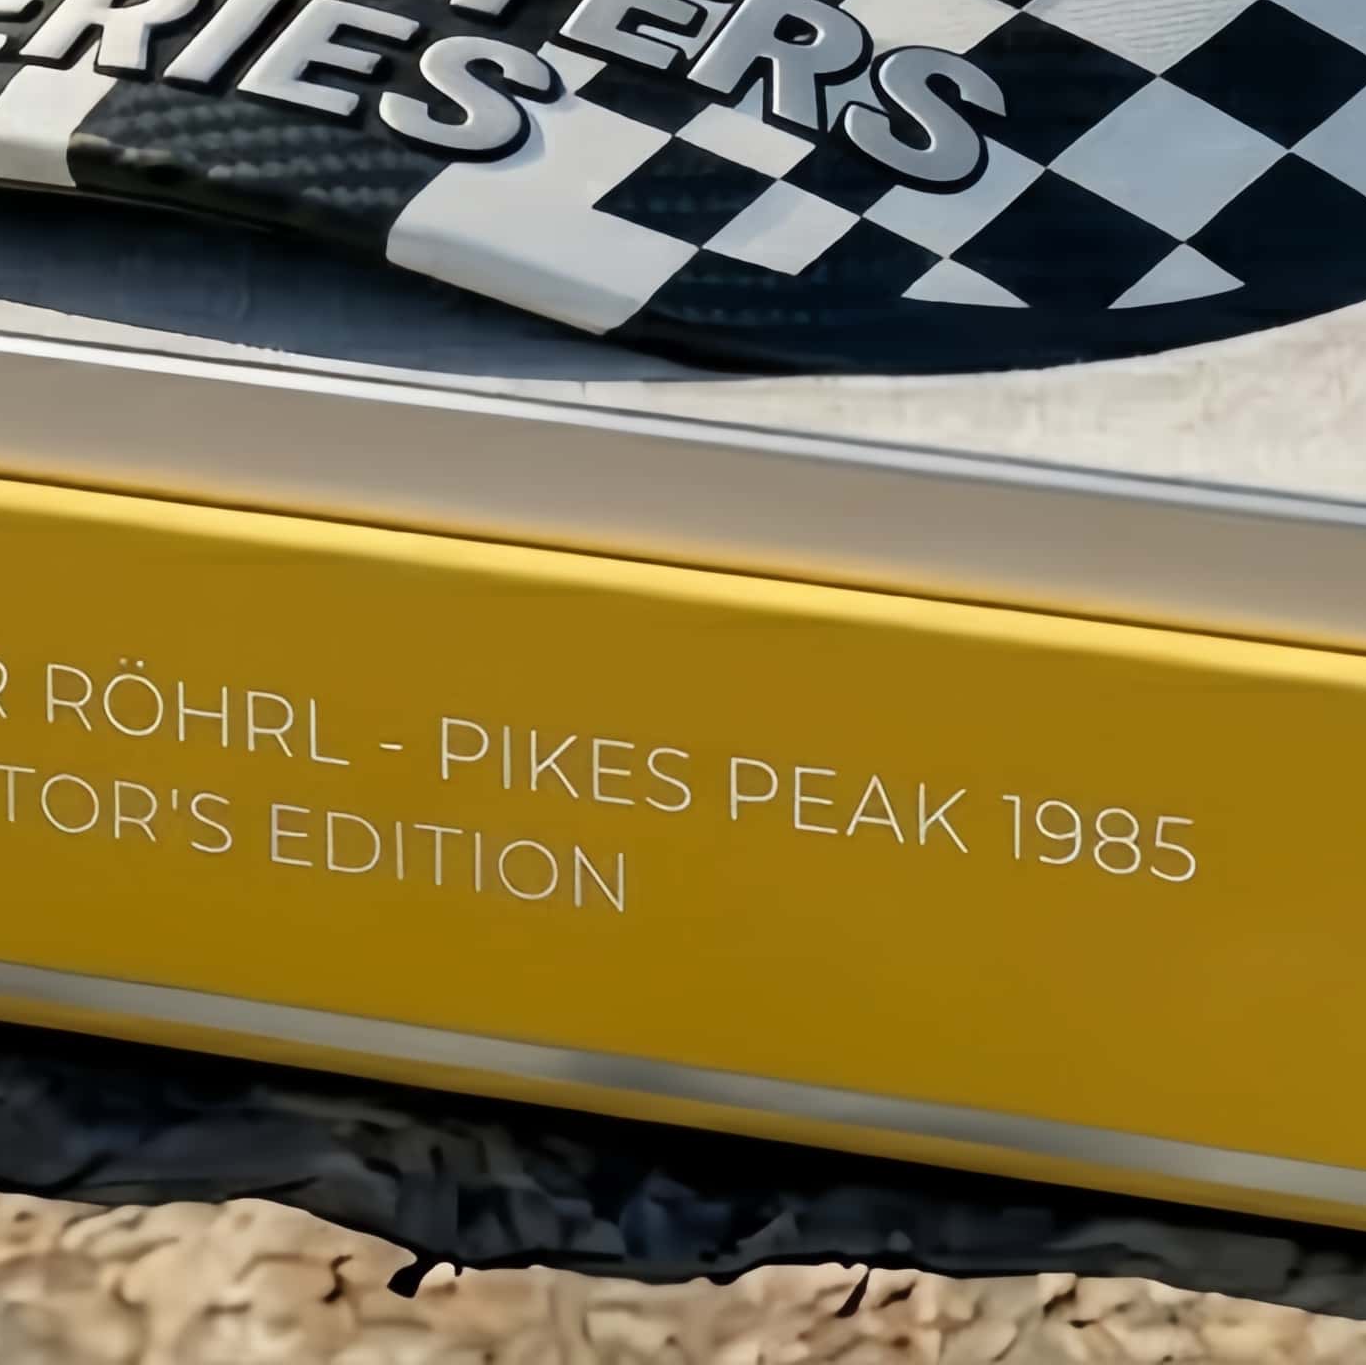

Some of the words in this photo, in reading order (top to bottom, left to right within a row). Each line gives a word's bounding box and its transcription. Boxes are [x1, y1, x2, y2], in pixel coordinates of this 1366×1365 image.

[45, 656, 350, 767] RÖHRL
[439, 715, 692, 813] PIKES
[730, 755, 969, 855] PEAK
[1001, 793, 1198, 883] 1985
[269, 802, 626, 913] EDITION
